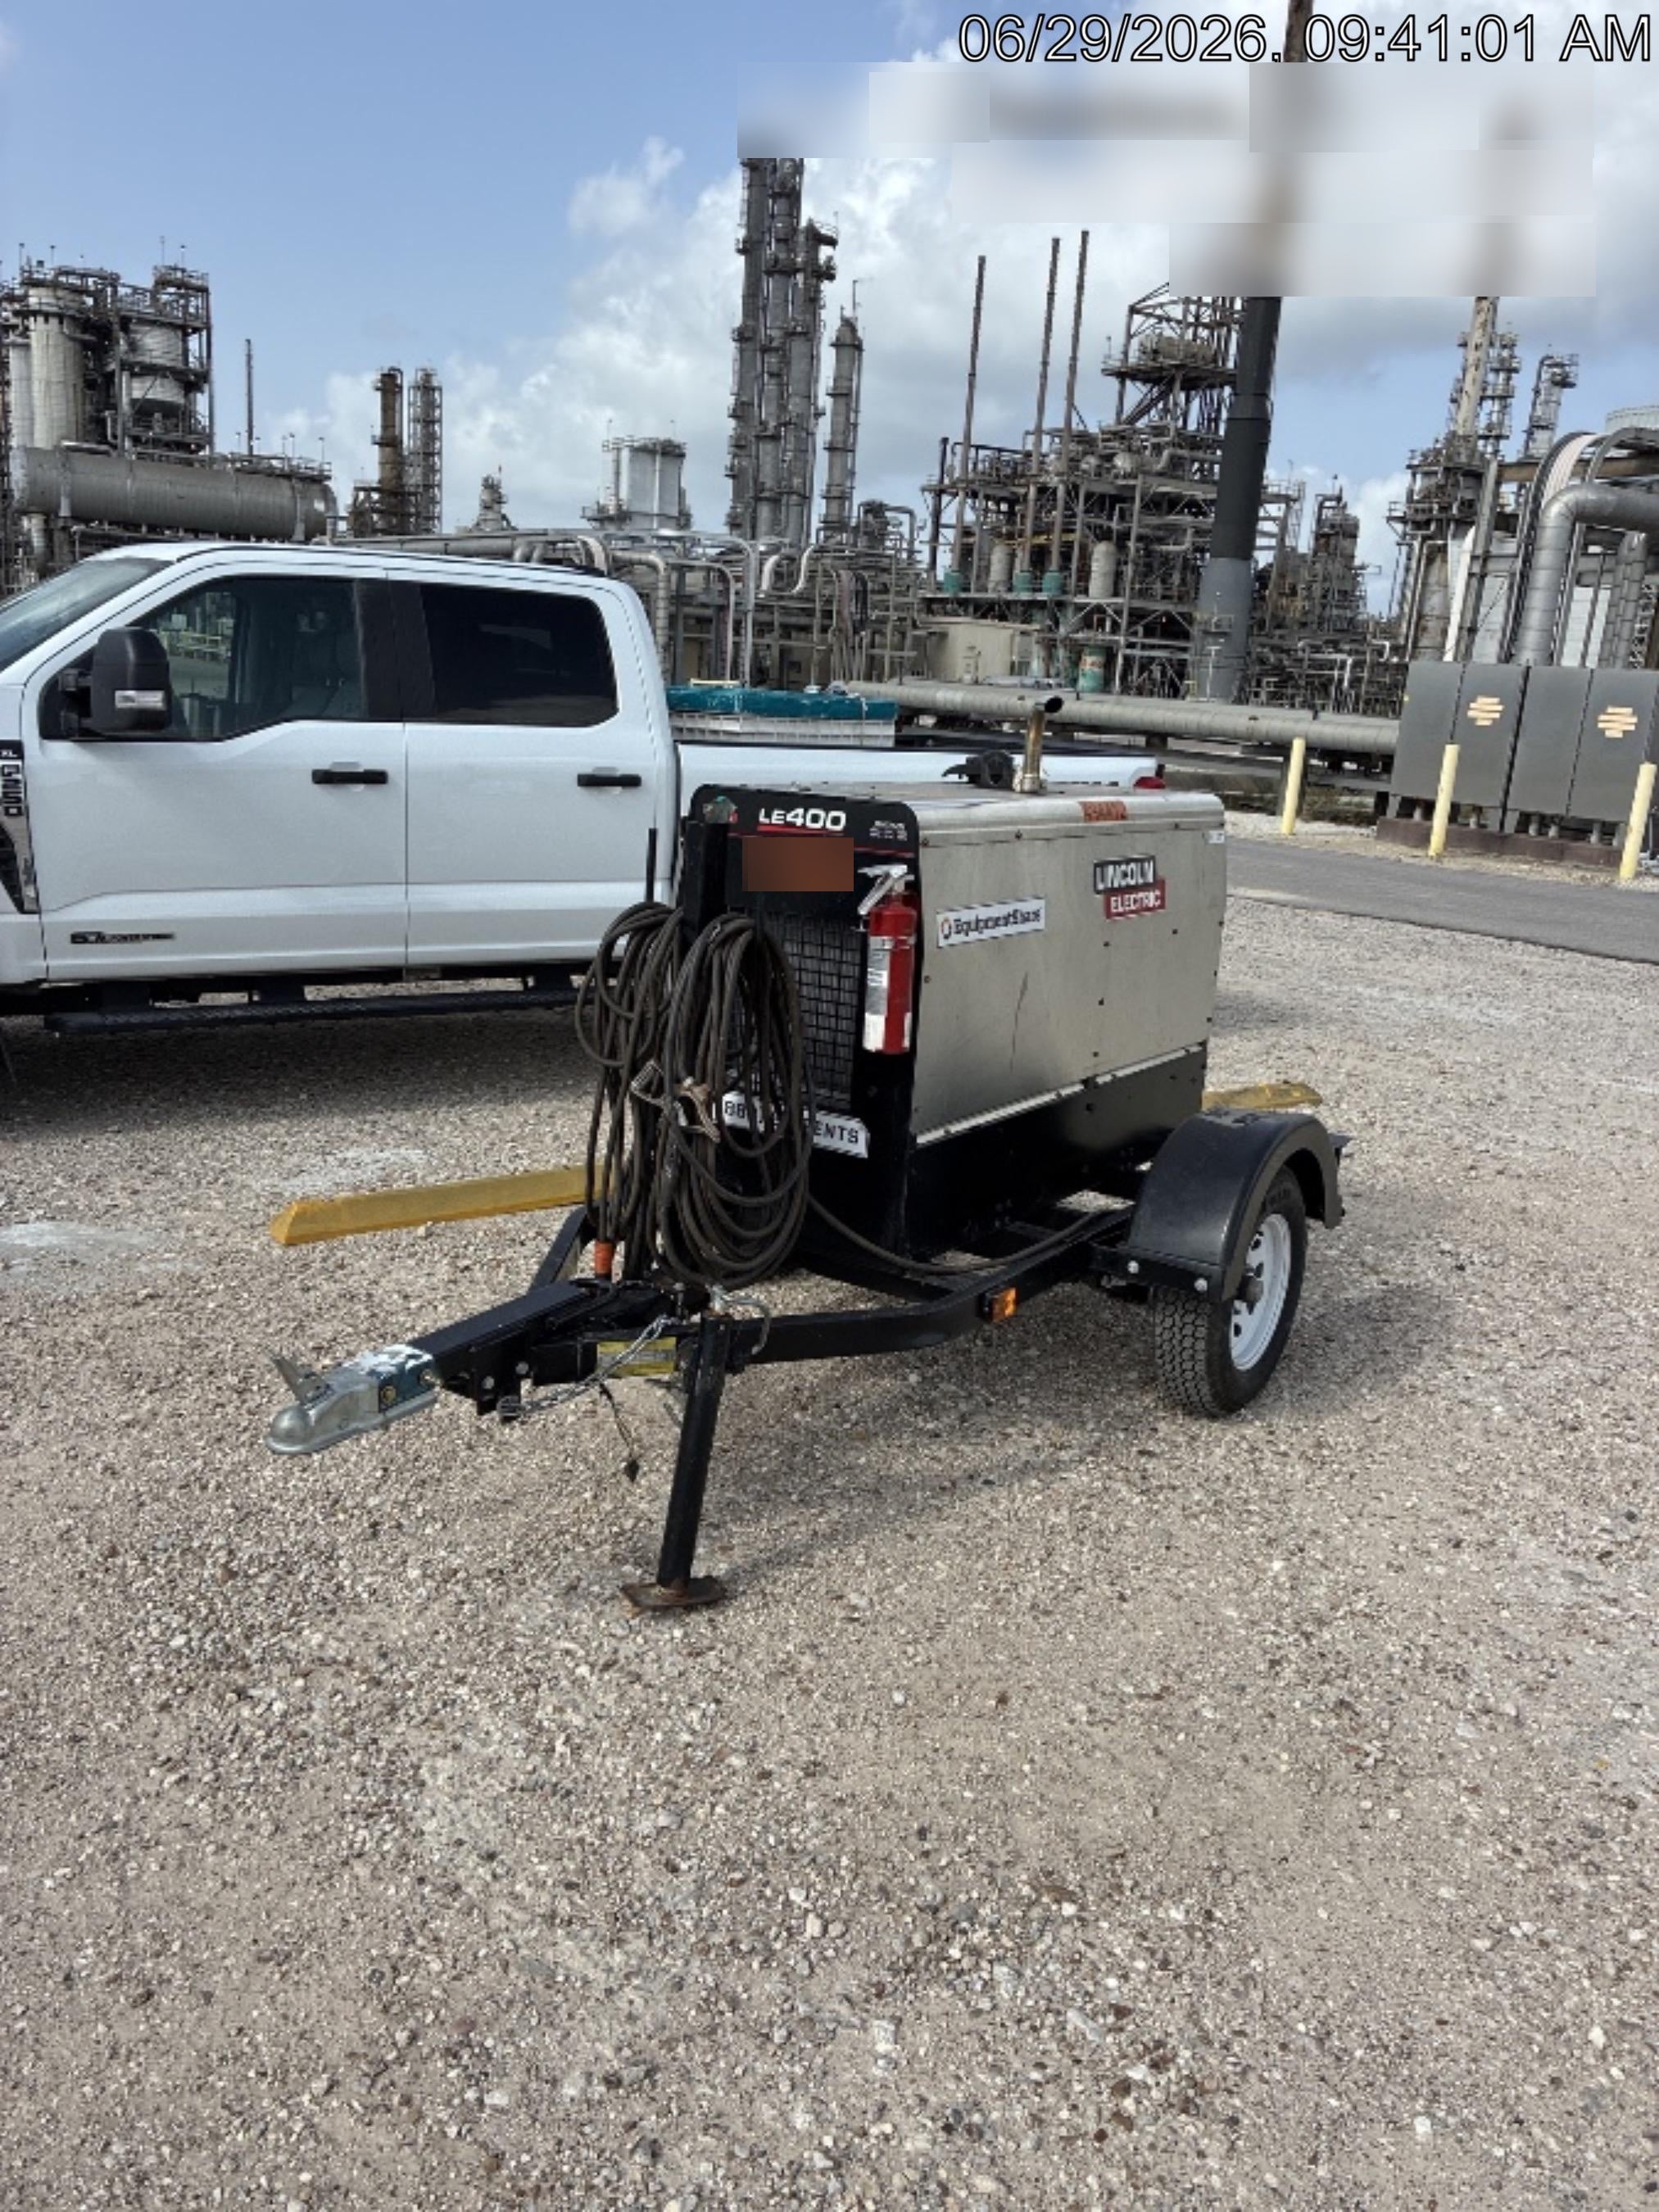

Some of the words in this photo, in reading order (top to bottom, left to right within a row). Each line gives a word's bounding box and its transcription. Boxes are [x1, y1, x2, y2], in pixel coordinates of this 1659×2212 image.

[759, 808, 846, 832] LE400
[1095, 860, 1154, 891] LINCOLN
[1110, 890, 1162, 913] ELECTRIC
